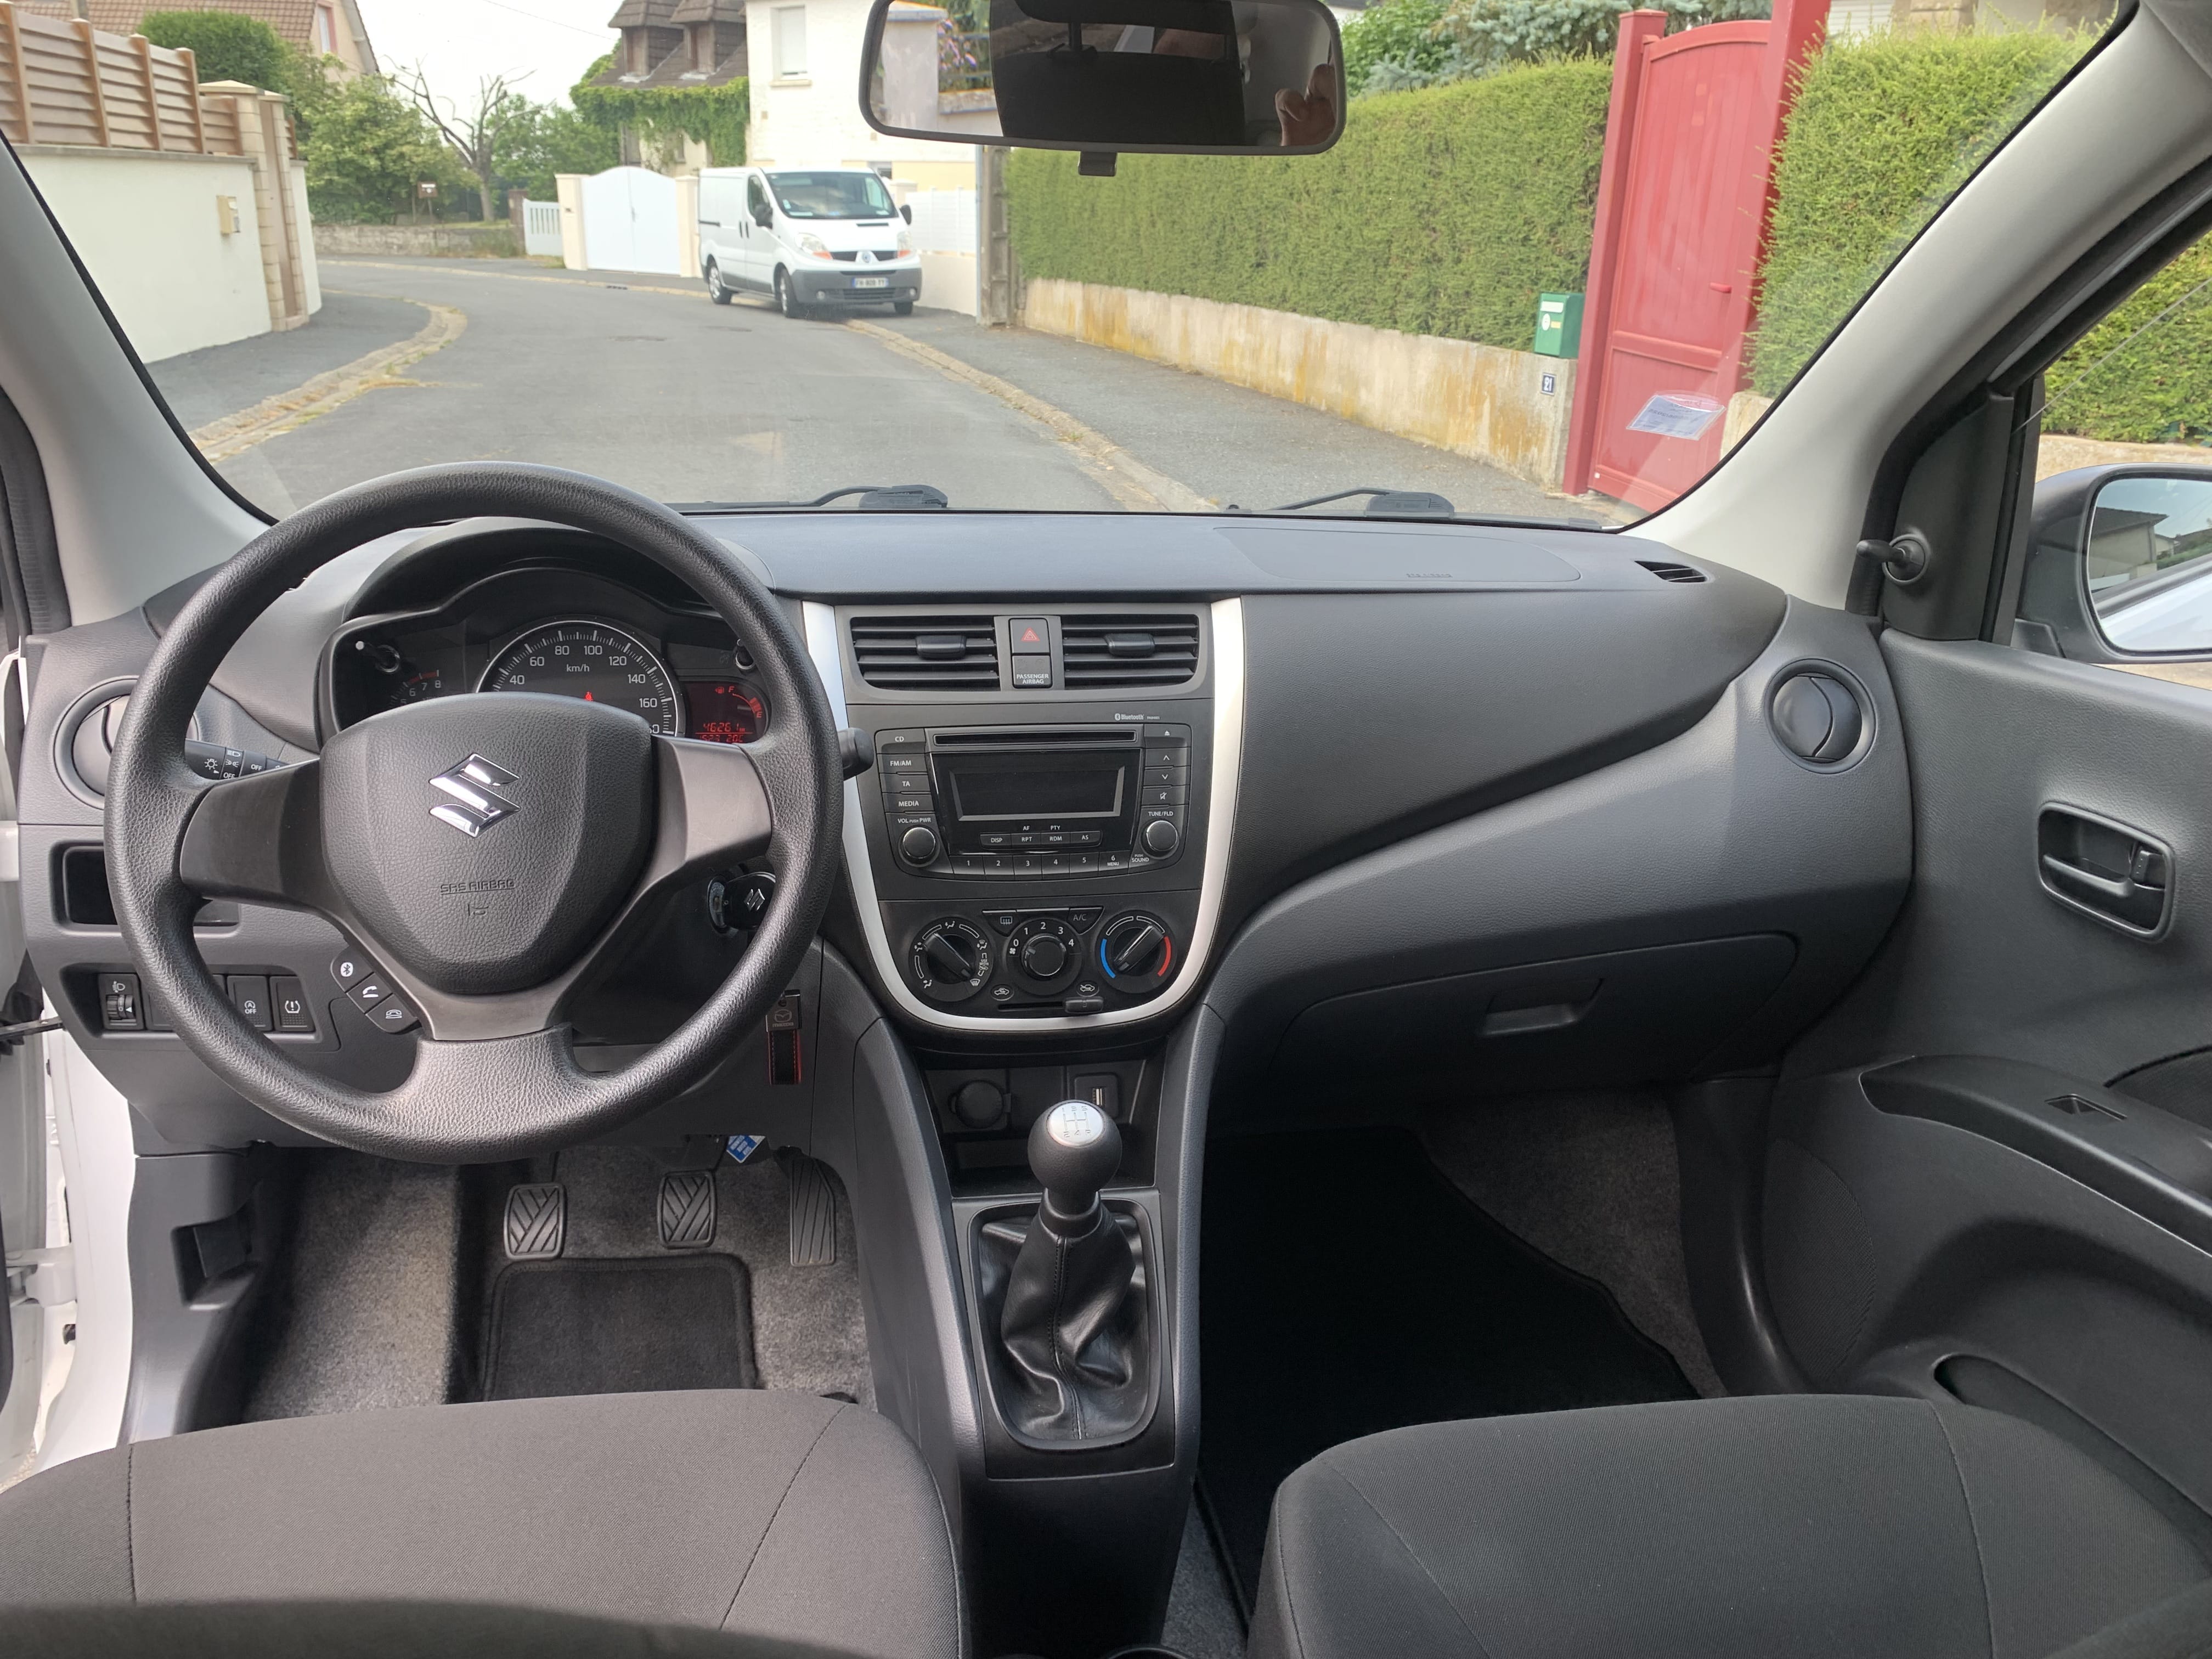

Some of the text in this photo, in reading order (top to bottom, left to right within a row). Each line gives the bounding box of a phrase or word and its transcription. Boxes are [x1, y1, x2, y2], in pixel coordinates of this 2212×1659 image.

[1543, 377, 1553, 391] 21
[555, 645, 569, 655] 80
[584, 645, 602, 655] 100
[529, 656, 544, 666] 60
[609, 656, 627, 666] 120
[566, 664, 590, 672] km/h
[435, 680, 441, 688] 8
[509, 675, 525, 685] 40
[628, 674, 645, 684] 140
[421, 682, 428, 691] 7
[409, 688, 416, 696] 6
[639, 698, 658, 708] 160
[469, 879, 516, 891] AIRBAG
[1040, 922, 1046, 930] 2
[1013, 939, 1019, 947] 0
